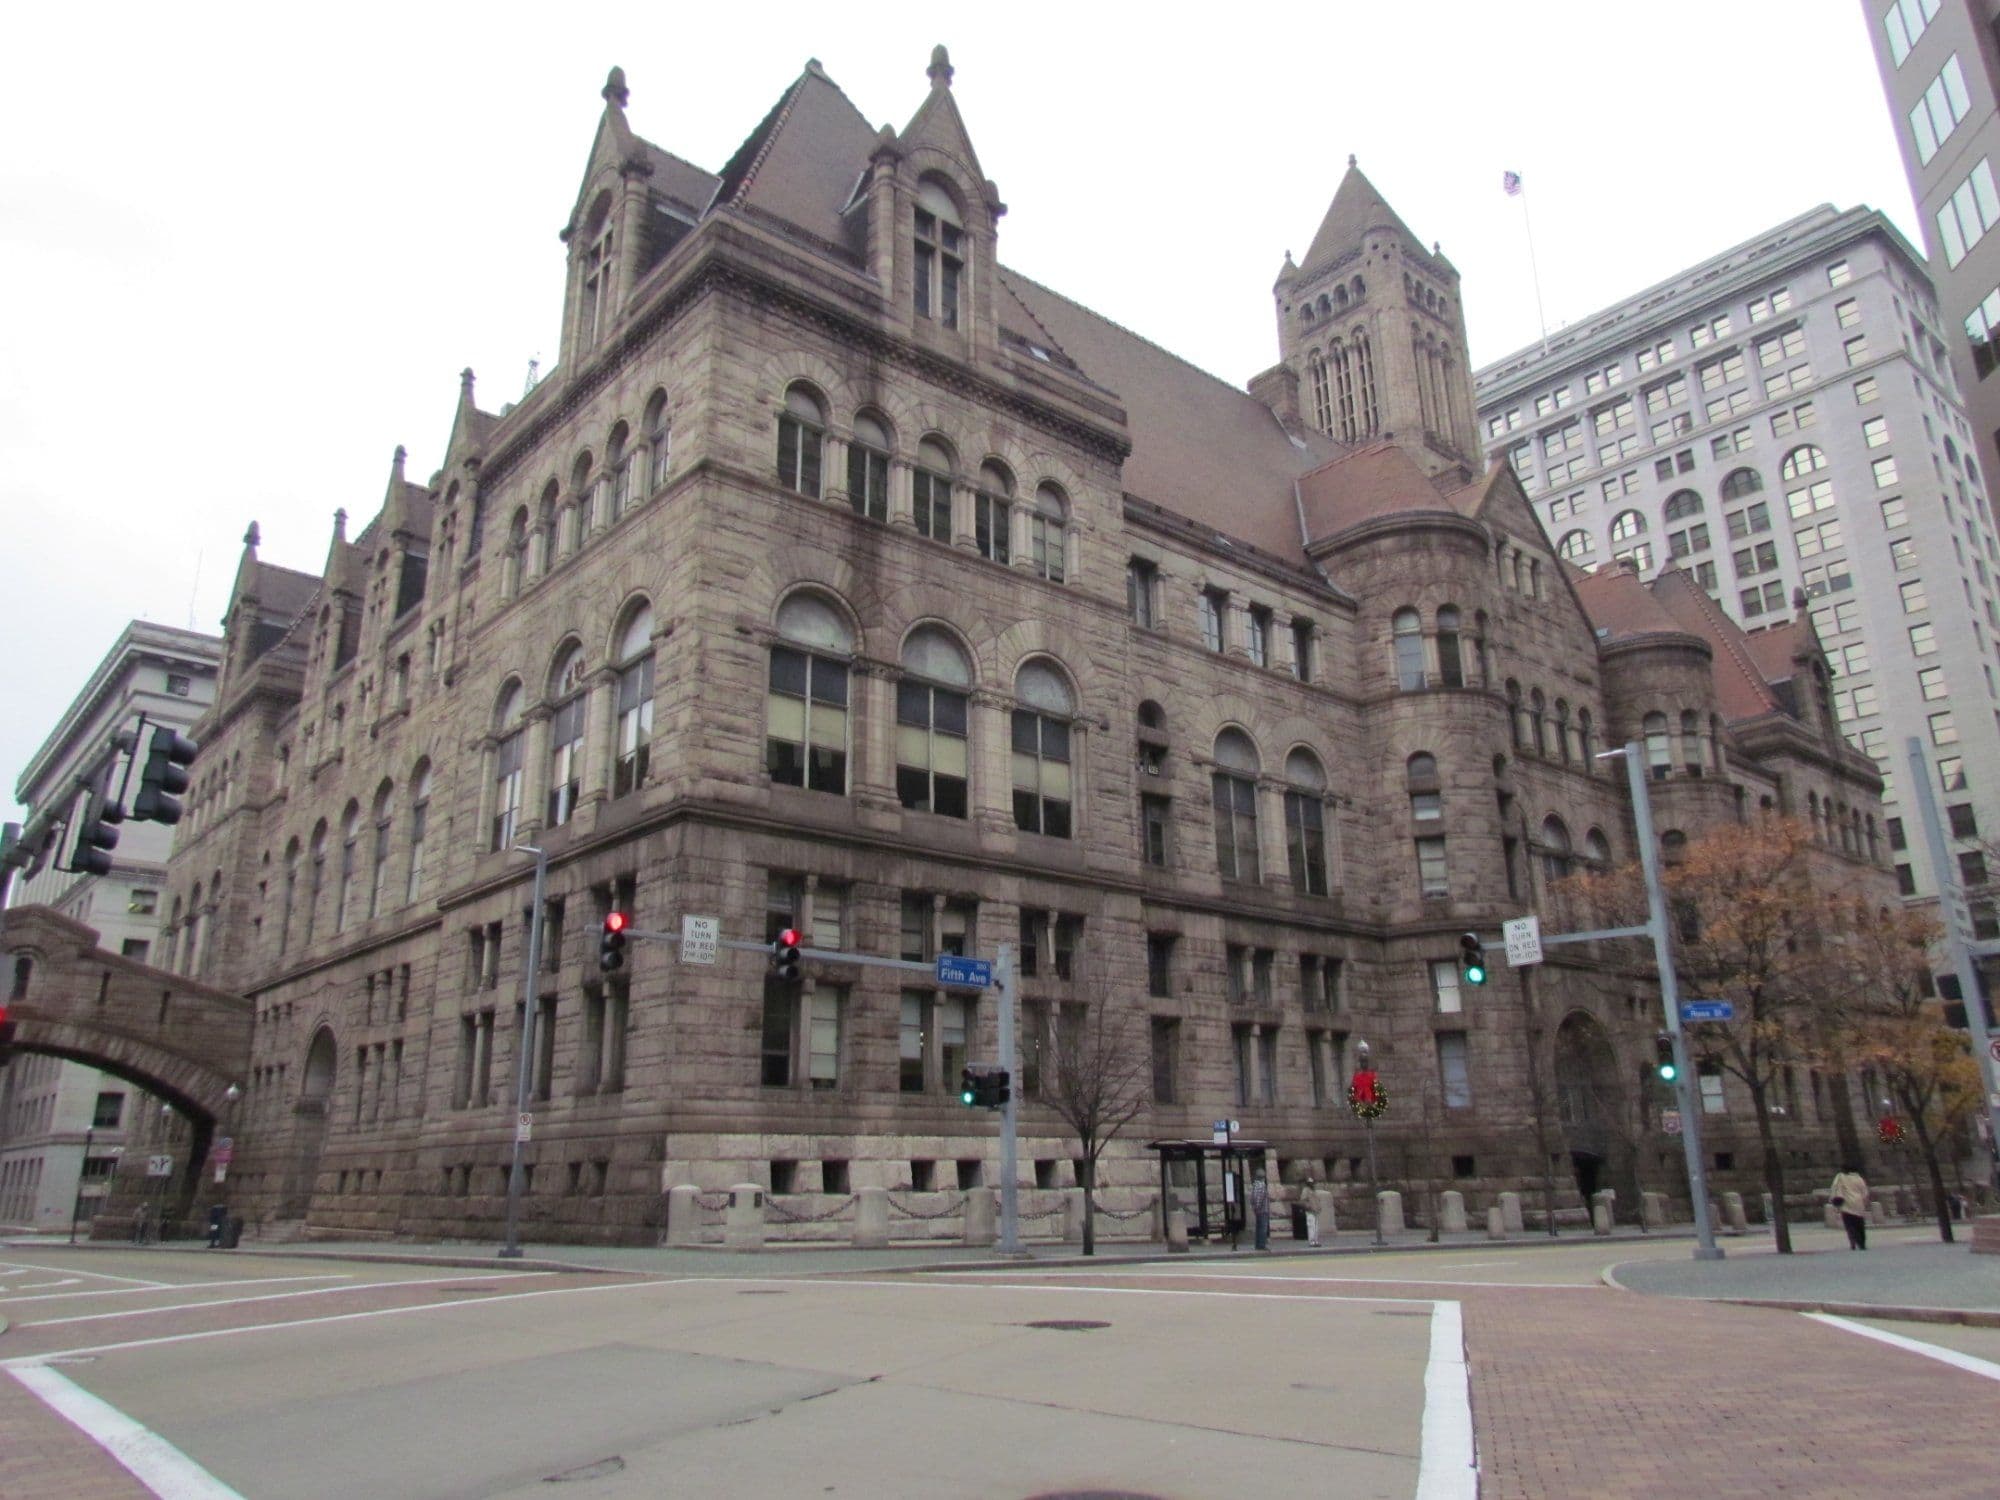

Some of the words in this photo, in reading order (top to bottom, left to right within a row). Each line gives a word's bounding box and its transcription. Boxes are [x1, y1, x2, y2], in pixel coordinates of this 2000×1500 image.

[695, 920, 707, 929] NO
[691, 931, 712, 940] TURN
[685, 940, 696, 950] ON
[699, 942, 716, 951] RED
[941, 967, 965, 981] Fifth
[969, 971, 987, 985] Ave
